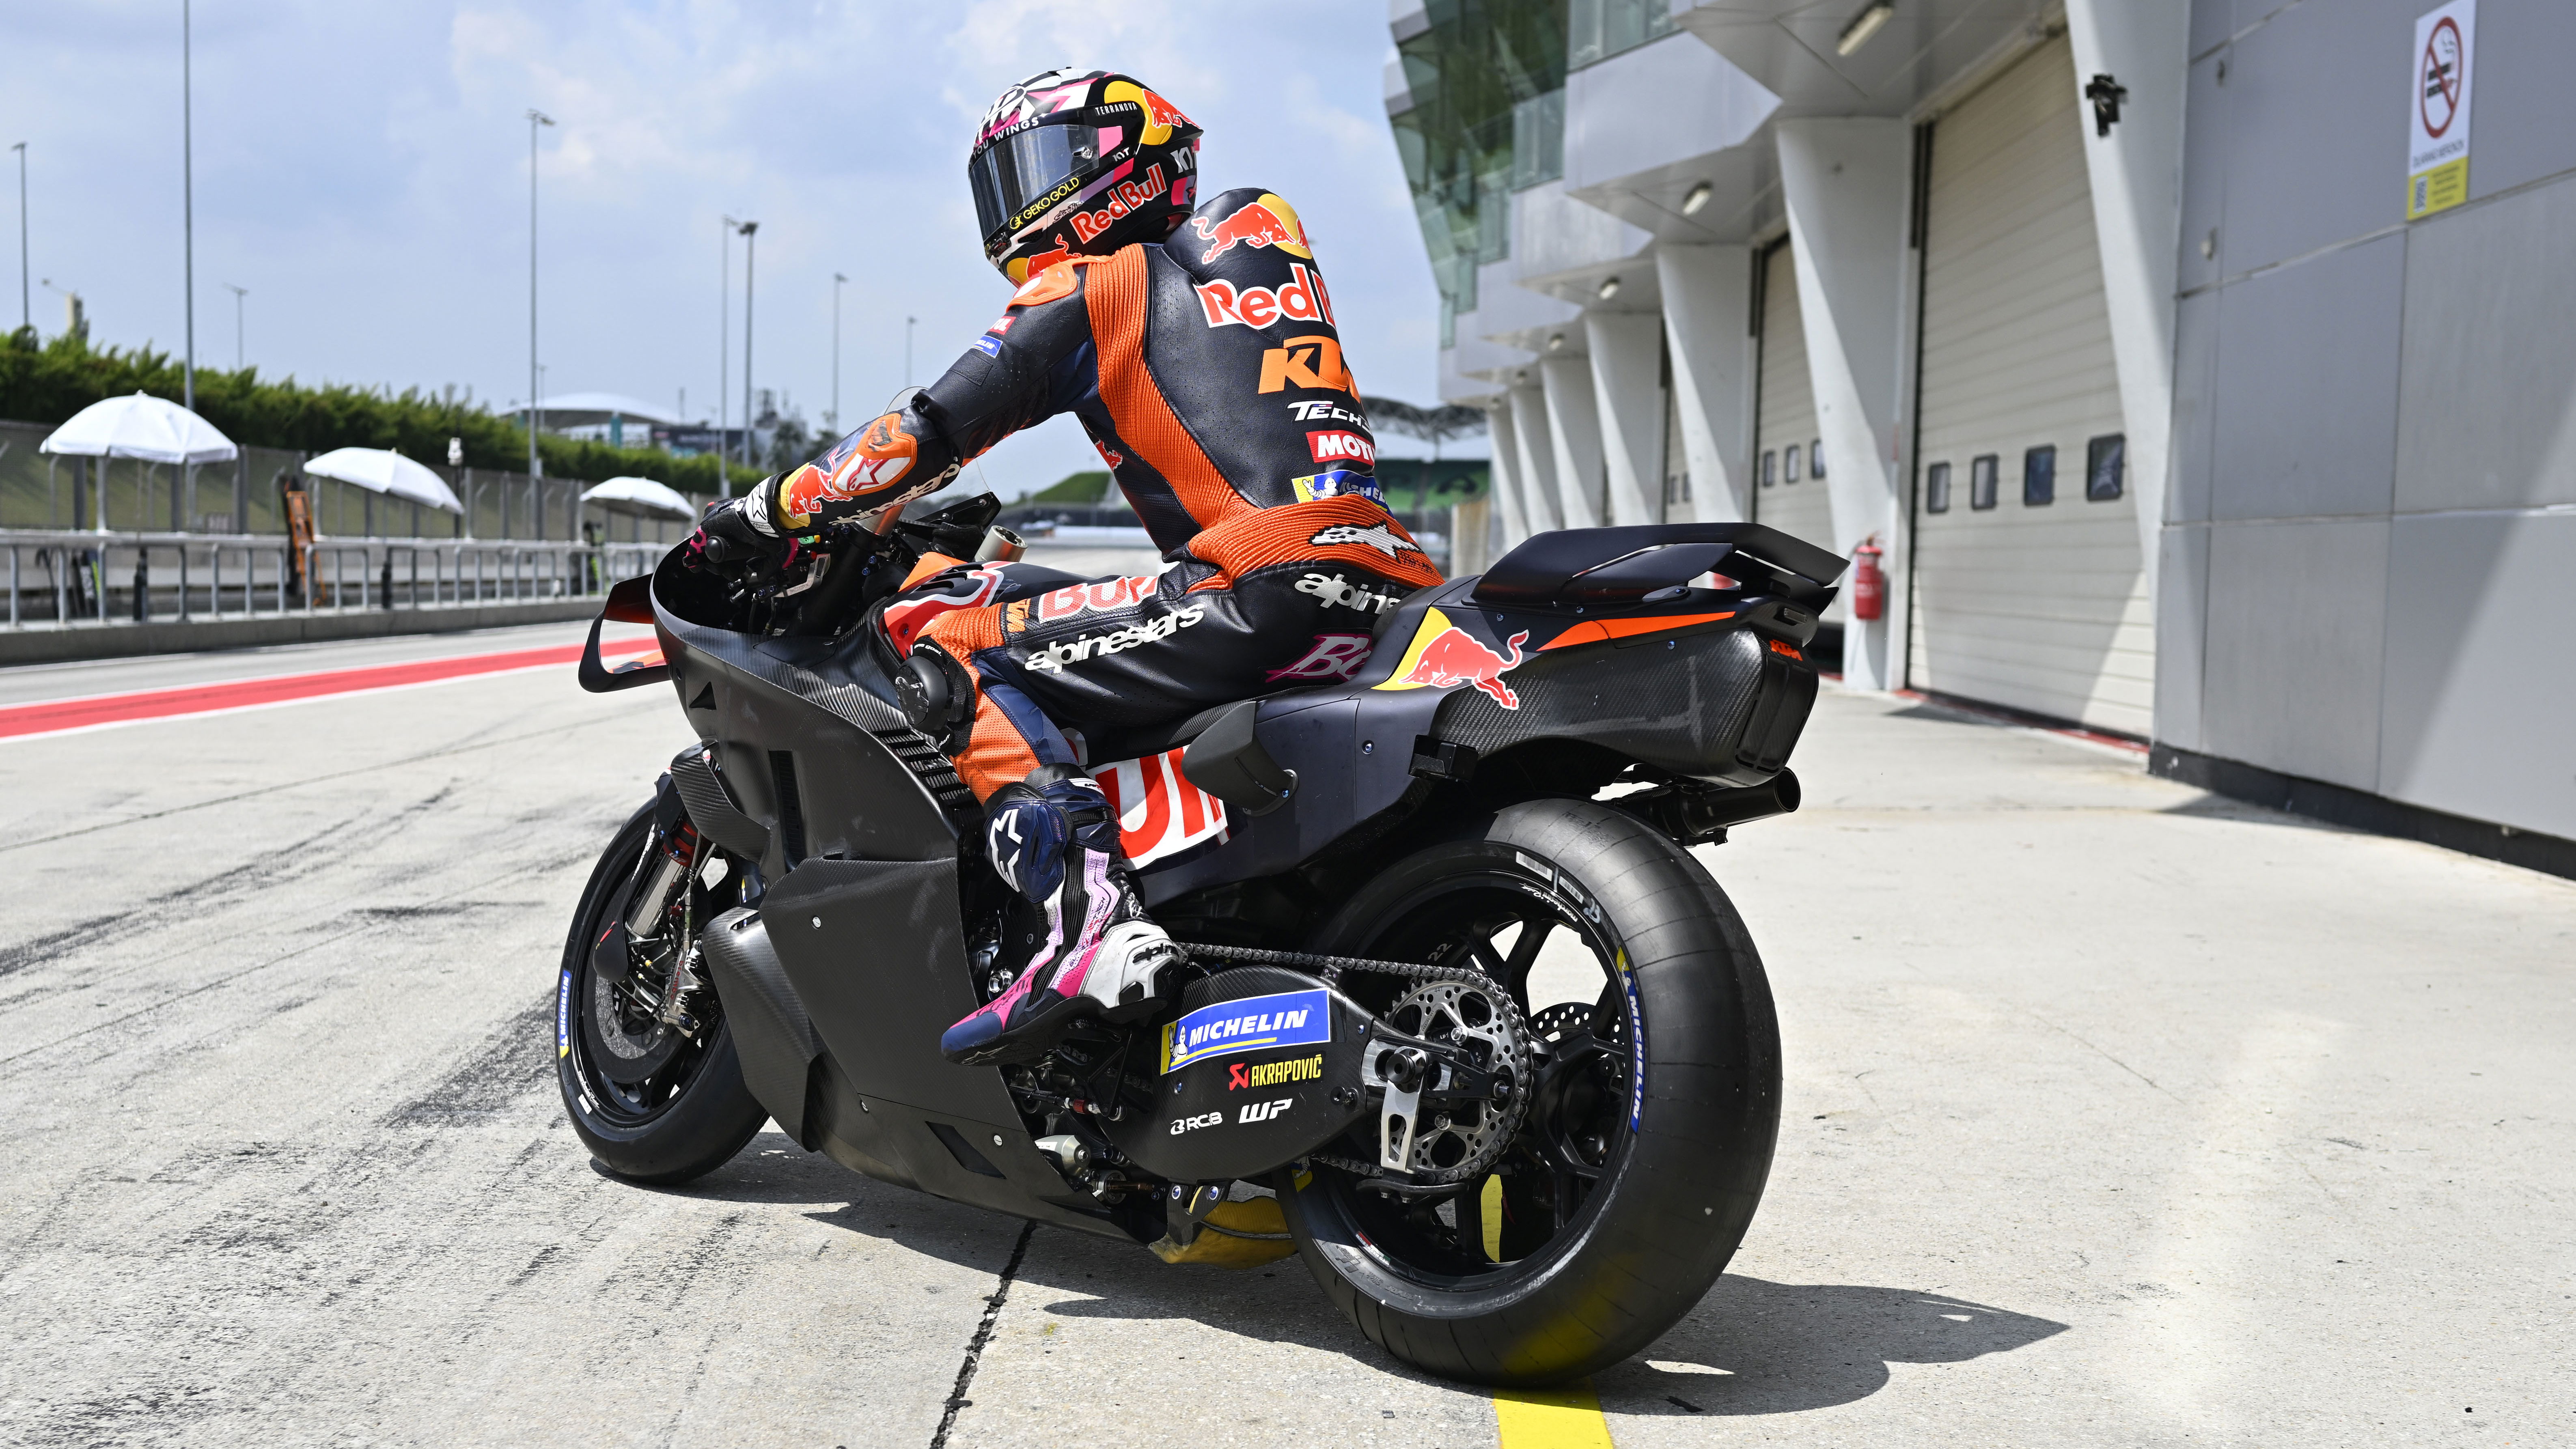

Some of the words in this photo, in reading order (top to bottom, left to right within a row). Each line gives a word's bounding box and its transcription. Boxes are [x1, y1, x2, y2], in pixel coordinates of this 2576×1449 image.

[1095, 102, 1137, 116] TERRANOVA
[973, 139, 989, 159] YOU
[994, 117, 1039, 141] WINGS
[1112, 146, 1130, 162] KYT
[1023, 197, 1051, 220] GEKO
[1050, 177, 1079, 201] GOLD
[1069, 188, 1132, 244] Red
[1117, 162, 1167, 211] Bull
[1192, 262, 1323, 330] Red
[1317, 434, 1375, 463] MOTU
[1294, 573, 1401, 611] alpine
[1006, 598, 1031, 633] TM
[1024, 603, 1206, 674] alpinestars
[1769, 639, 1803, 662] KTM
[1541, 891, 1579, 922] marchesini
[670, 960, 685, 1001] brembo
[560, 975, 569, 1035] MICHELIN
[1189, 1009, 1308, 1047] MICHELIN
[1251, 1054, 1323, 1087] AKRAPOVIČ
[1628, 995, 1644, 1120] MICHELIN
[1186, 1111, 1224, 1131] RCB
[1238, 1098, 1293, 1124] WP
